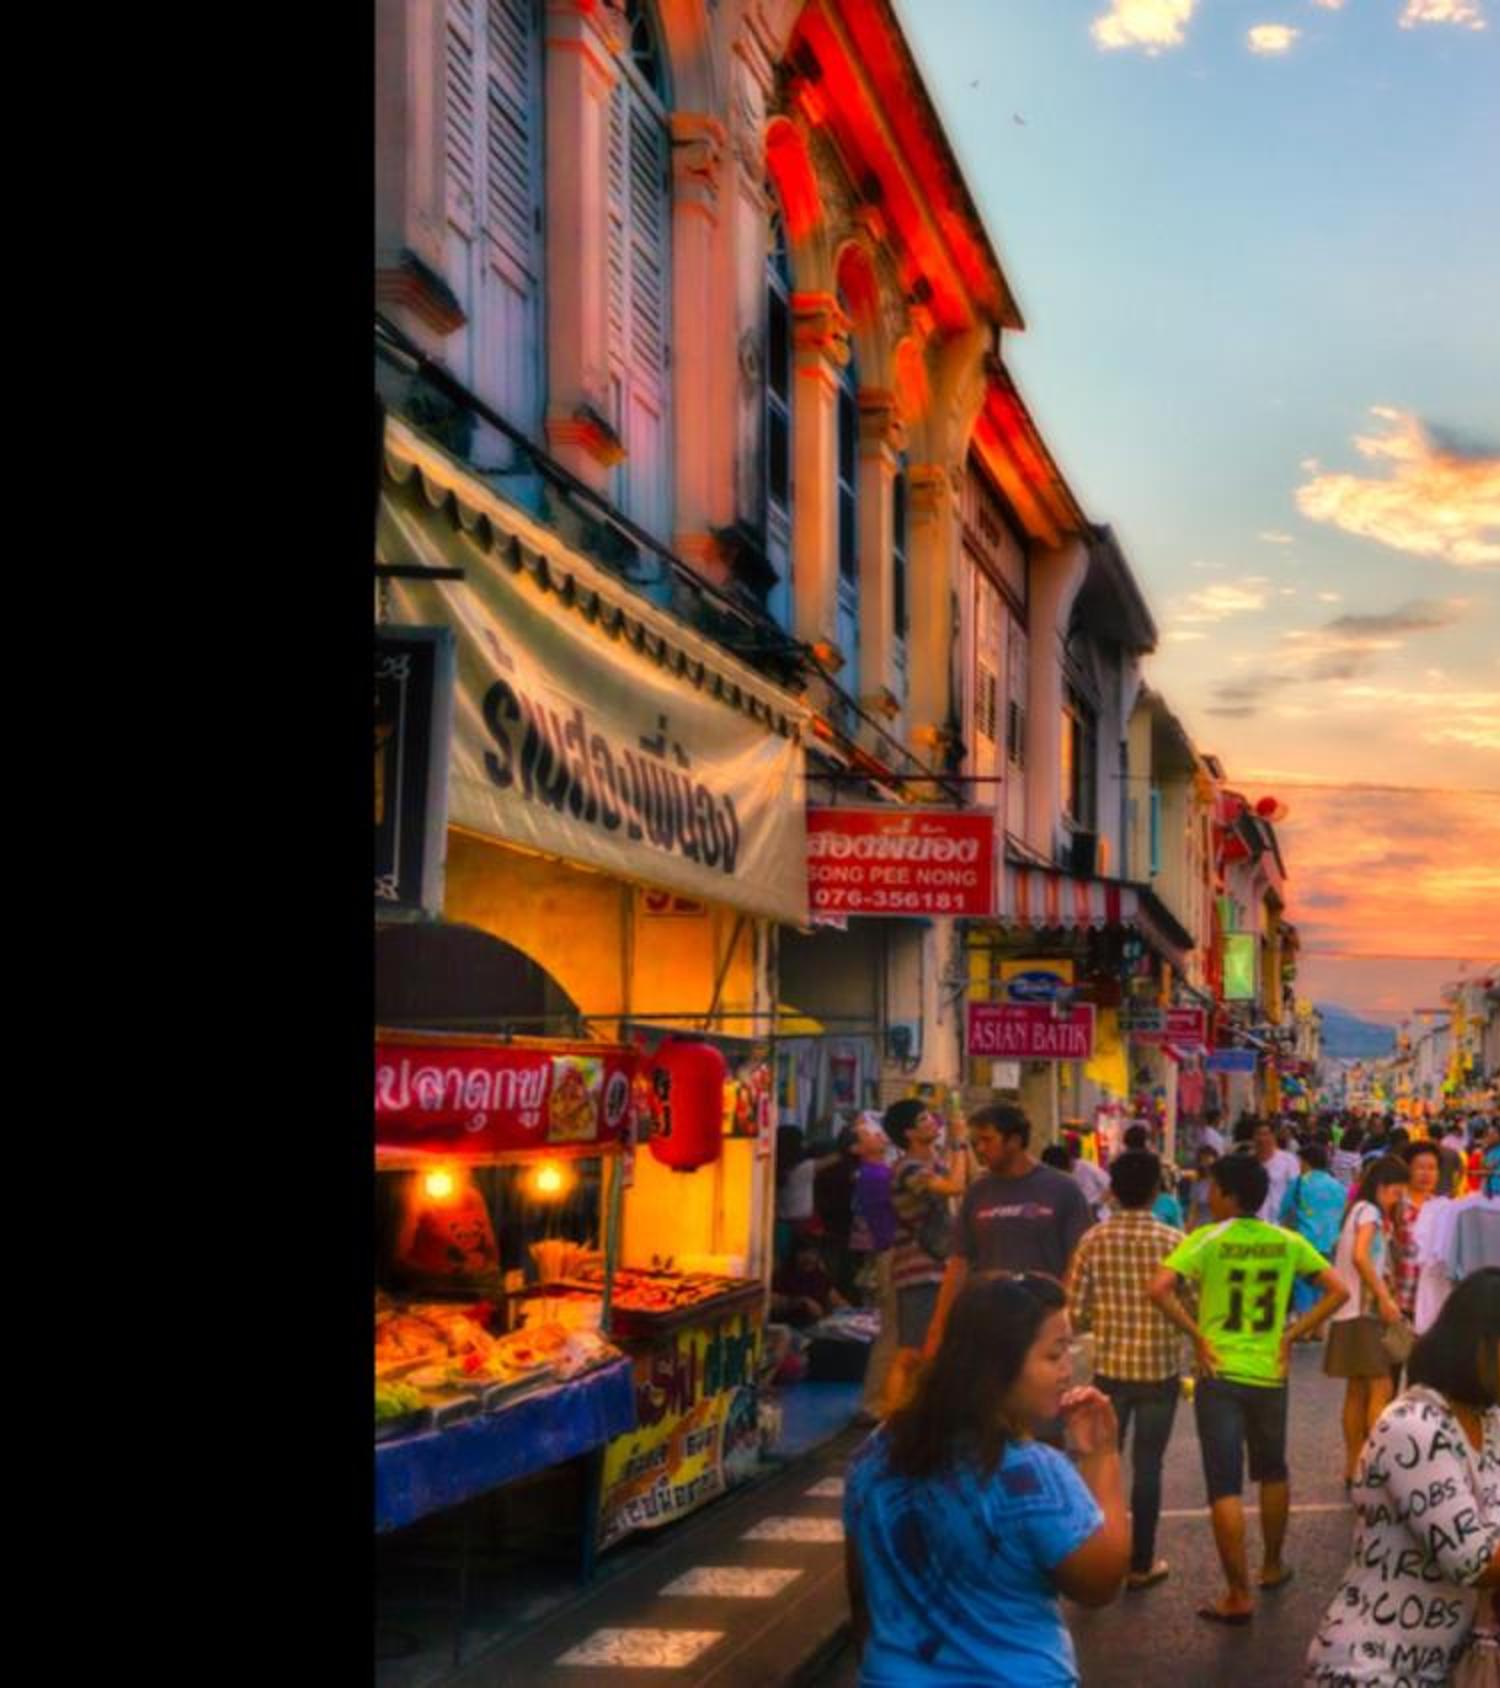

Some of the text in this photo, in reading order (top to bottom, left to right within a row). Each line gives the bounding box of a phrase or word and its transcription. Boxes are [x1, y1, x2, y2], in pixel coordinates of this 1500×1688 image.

[869, 866, 911, 886] PEE
[916, 869, 977, 887] NONG
[815, 888, 966, 911] 076-356181
[970, 1020, 1089, 1054] ASIAN BATIK
[1222, 1268, 1280, 1333] 13
